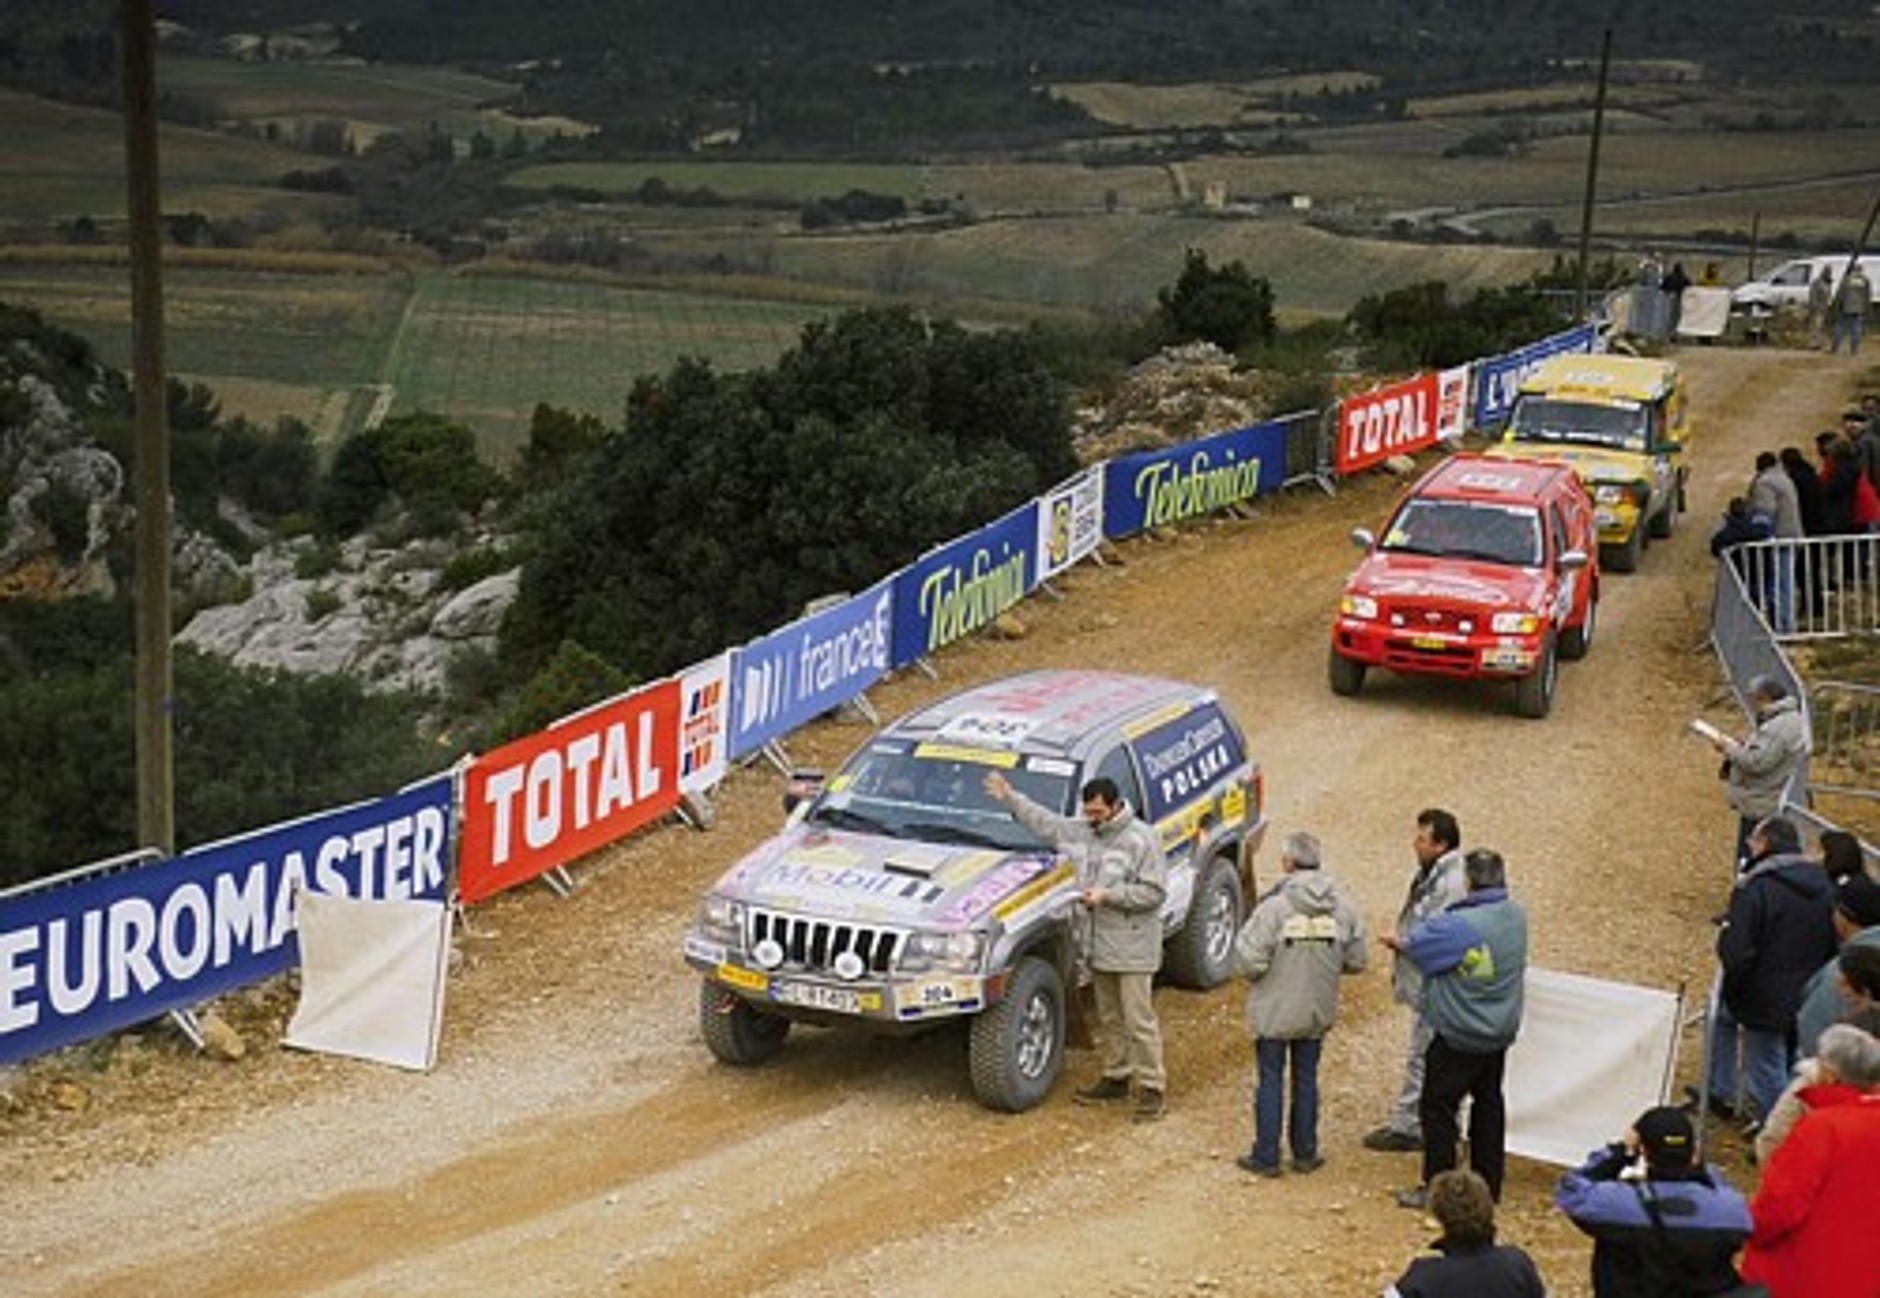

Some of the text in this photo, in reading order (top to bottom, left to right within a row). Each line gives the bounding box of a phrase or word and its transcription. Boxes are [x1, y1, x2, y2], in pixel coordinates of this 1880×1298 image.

[1348, 390, 1430, 459] TOTAL
[485, 711, 661, 867] TOTAL
[1161, 744, 1231, 803] POLSKA
[0, 806, 444, 1034] EUROMASTER
